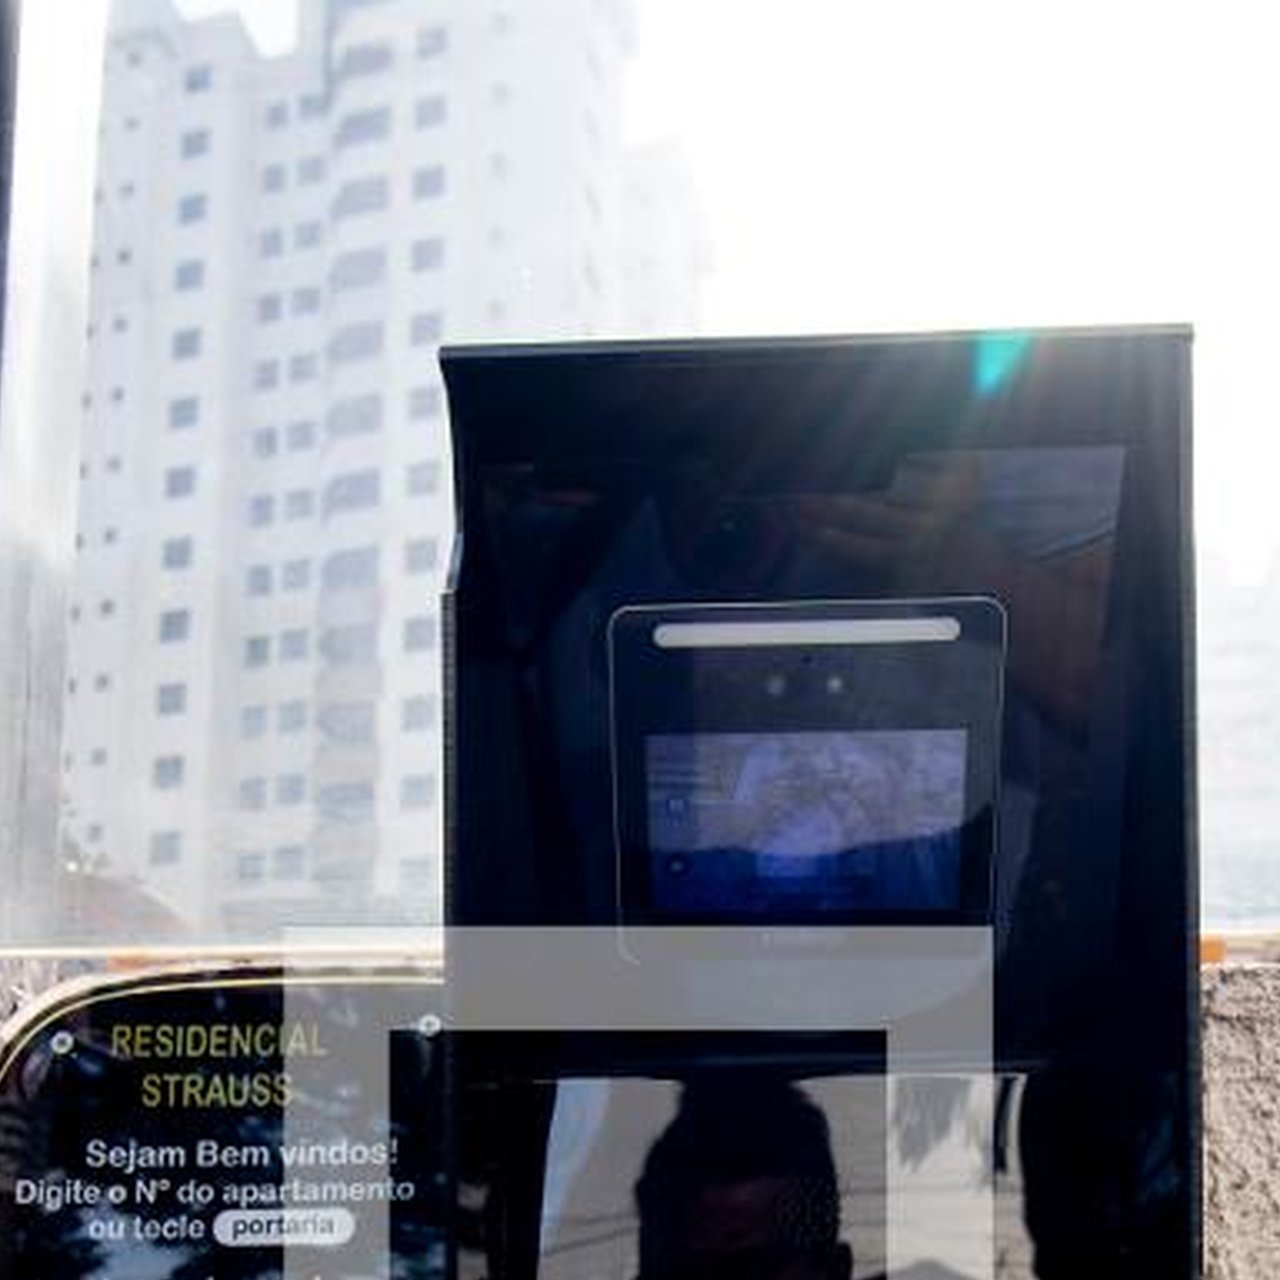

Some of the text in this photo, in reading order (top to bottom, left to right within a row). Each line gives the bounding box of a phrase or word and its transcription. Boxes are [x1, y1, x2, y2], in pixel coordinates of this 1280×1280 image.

[111, 1024, 327, 1057] RESIDENCIAL
[142, 1073, 293, 1108] STRAUSS
[86, 1138, 399, 1172] Sejam Bem vindos!
[16, 1180, 100, 1211] Digite
[109, 1185, 127, 1204] o
[178, 1179, 215, 1203] do
[223, 1178, 415, 1207] apartamento
[89, 1213, 335, 1240] ou tecle portaria
